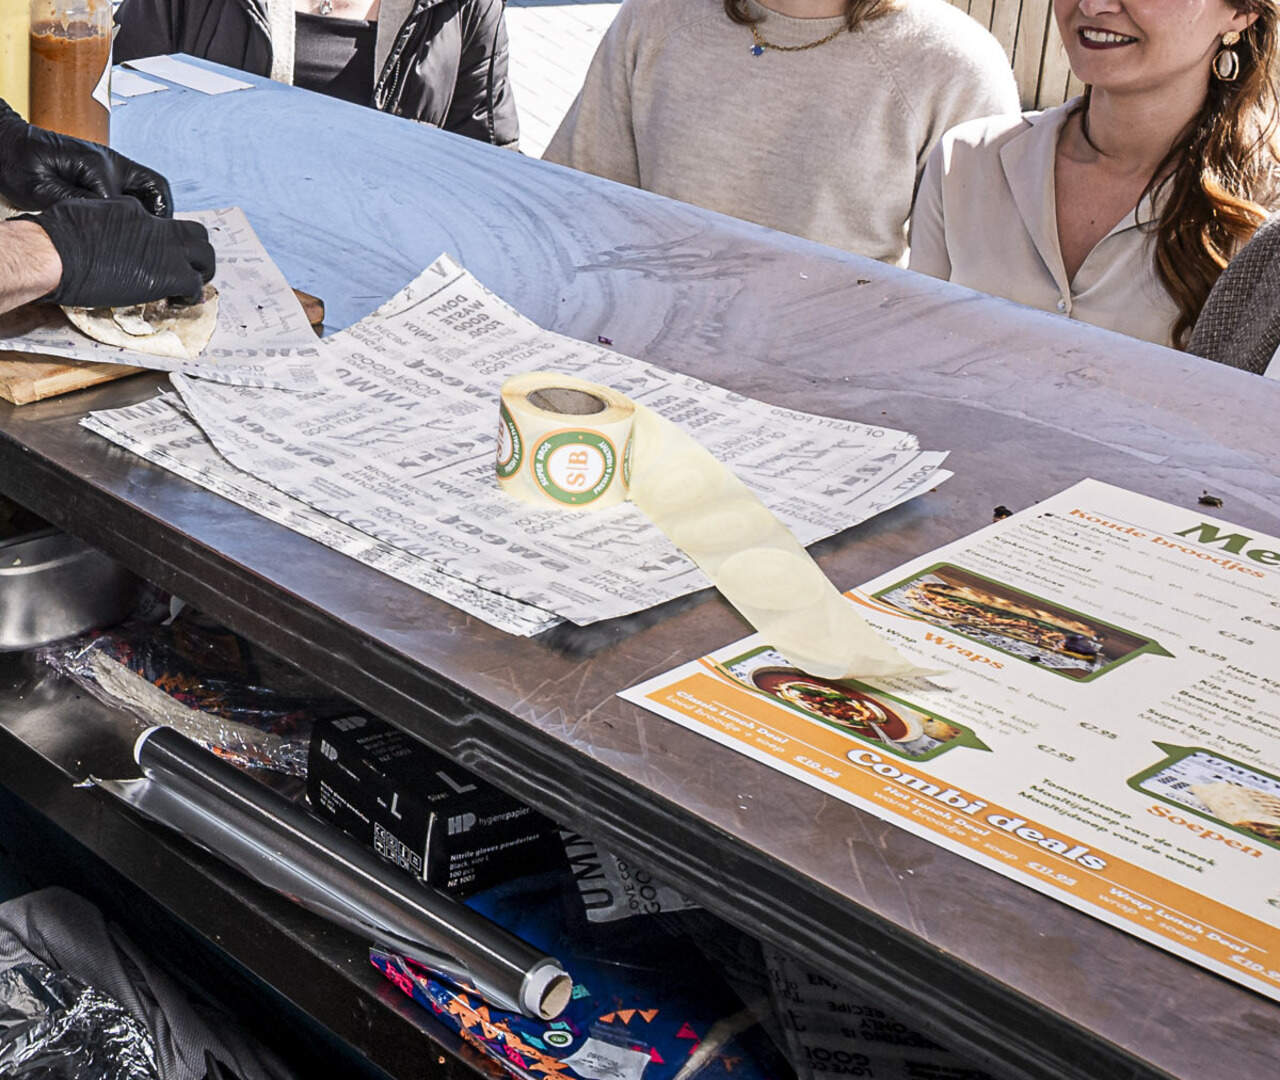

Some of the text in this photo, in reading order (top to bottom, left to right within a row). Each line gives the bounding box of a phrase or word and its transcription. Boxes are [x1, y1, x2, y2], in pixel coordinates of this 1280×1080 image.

[1070, 509, 1264, 578] Koude broodjes
[925, 632, 1004, 669] Wraps
[1179, 690, 1241, 716] Beenham
[1200, 680, 1221, 690] Kip
[675, 689, 790, 745] Classic Lunch Deal
[1147, 708, 1184, 725] Super
[1188, 725, 1211, 736] Kip
[448, 812, 476, 836] HP
[846, 748, 1107, 871] Combi deals
[883, 785, 990, 836] Hot Lunch Deal
[1043, 779, 1131, 819] Tomatensoep
[450, 834, 540, 861] Nitrile gloves powderless
[1018, 791, 1203, 873] Maaltijdsoep van de week
[1030, 785, 1214, 866] Maaltijdsoep van de week
[1147, 806, 1262, 858] Soepen
[1109, 887, 1251, 953] Wrap Lunch Deal
